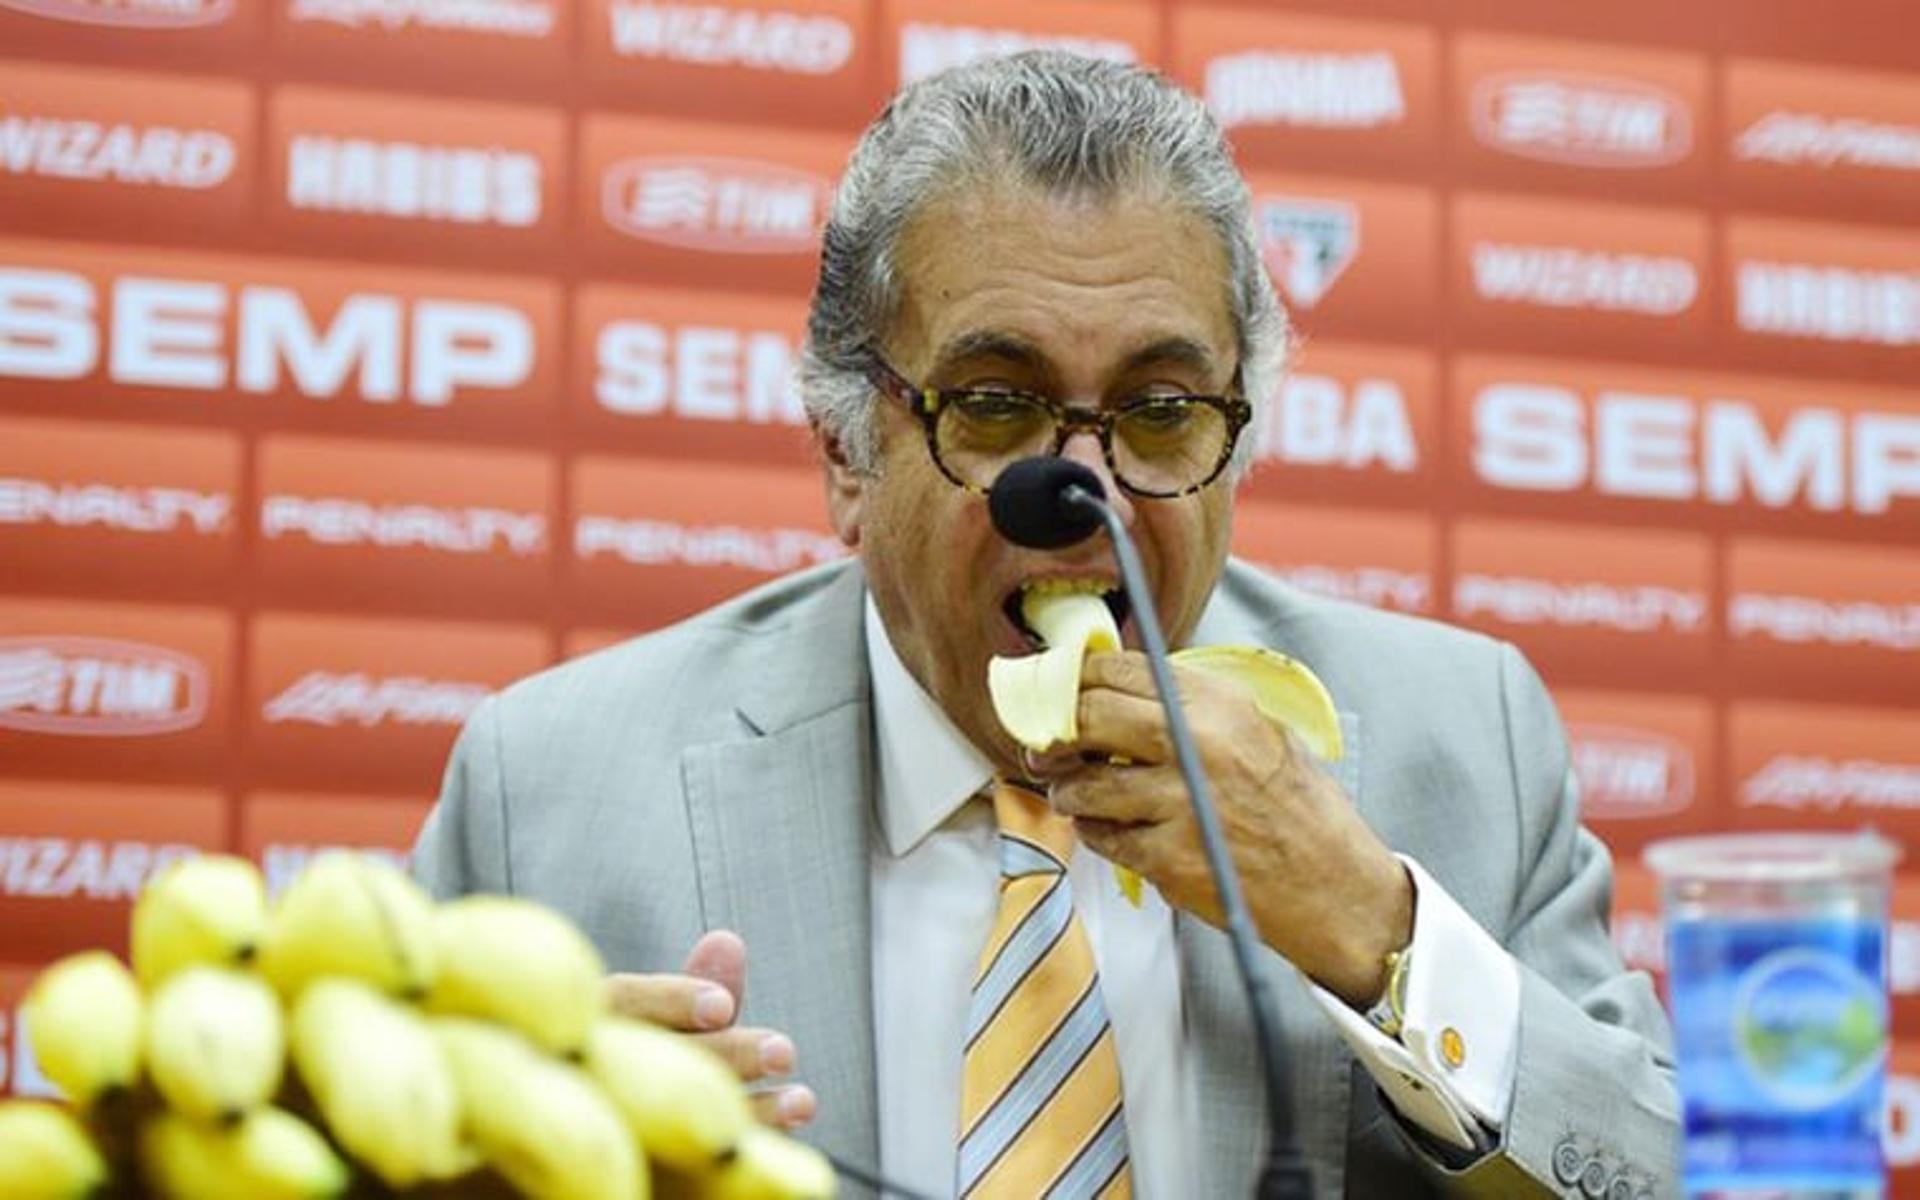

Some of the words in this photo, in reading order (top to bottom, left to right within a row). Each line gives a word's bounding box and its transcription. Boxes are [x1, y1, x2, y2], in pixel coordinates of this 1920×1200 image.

[0, 267, 535, 404] SEMP
[1473, 383, 1920, 512] SEMP
[262, 496, 543, 552] PENALTY
[1454, 576, 1704, 630] PENALTY
